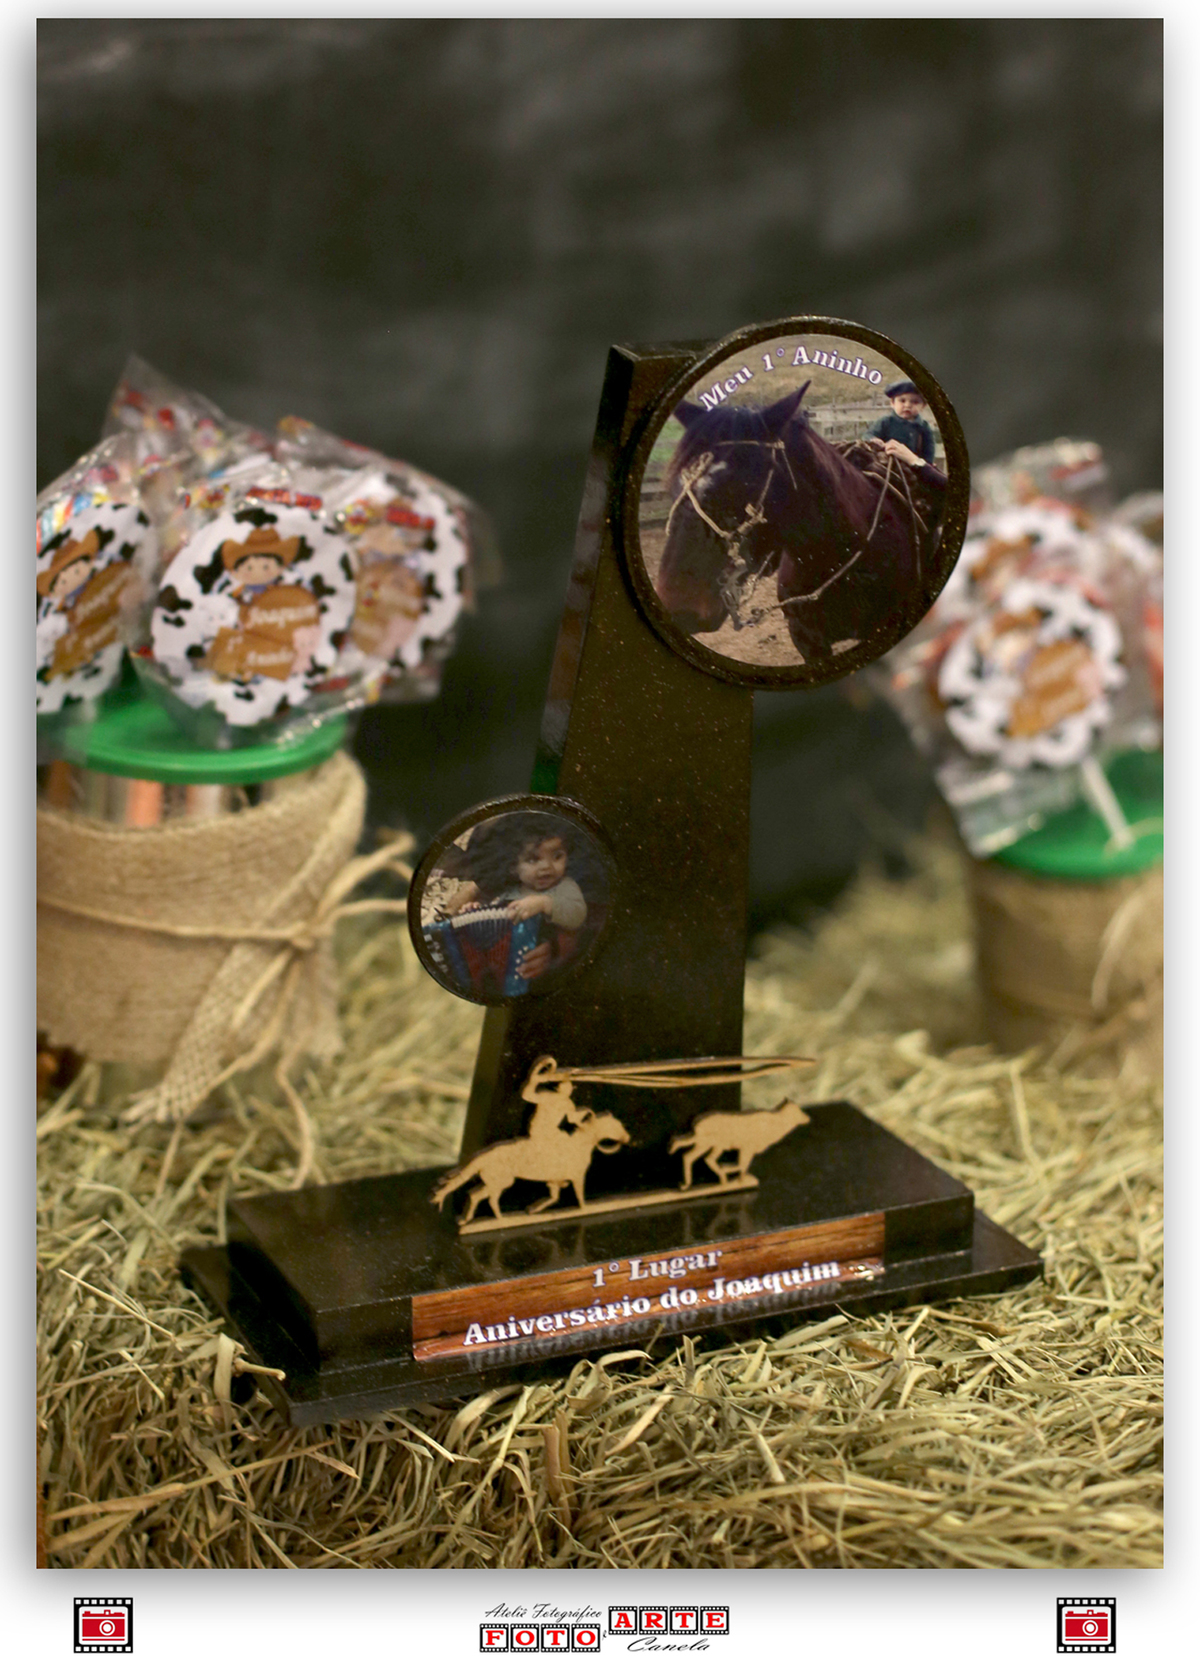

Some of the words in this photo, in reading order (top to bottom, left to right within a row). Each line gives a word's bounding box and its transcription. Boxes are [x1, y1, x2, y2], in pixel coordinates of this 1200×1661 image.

[699, 365, 753, 412] Meu
[792, 345, 883, 386] Aninho
[629, 1248, 723, 1282] Lugar
[463, 1295, 651, 1346] Aniversário
[660, 1286, 698, 1310] do
[707, 1260, 841, 1302] Joaquim
